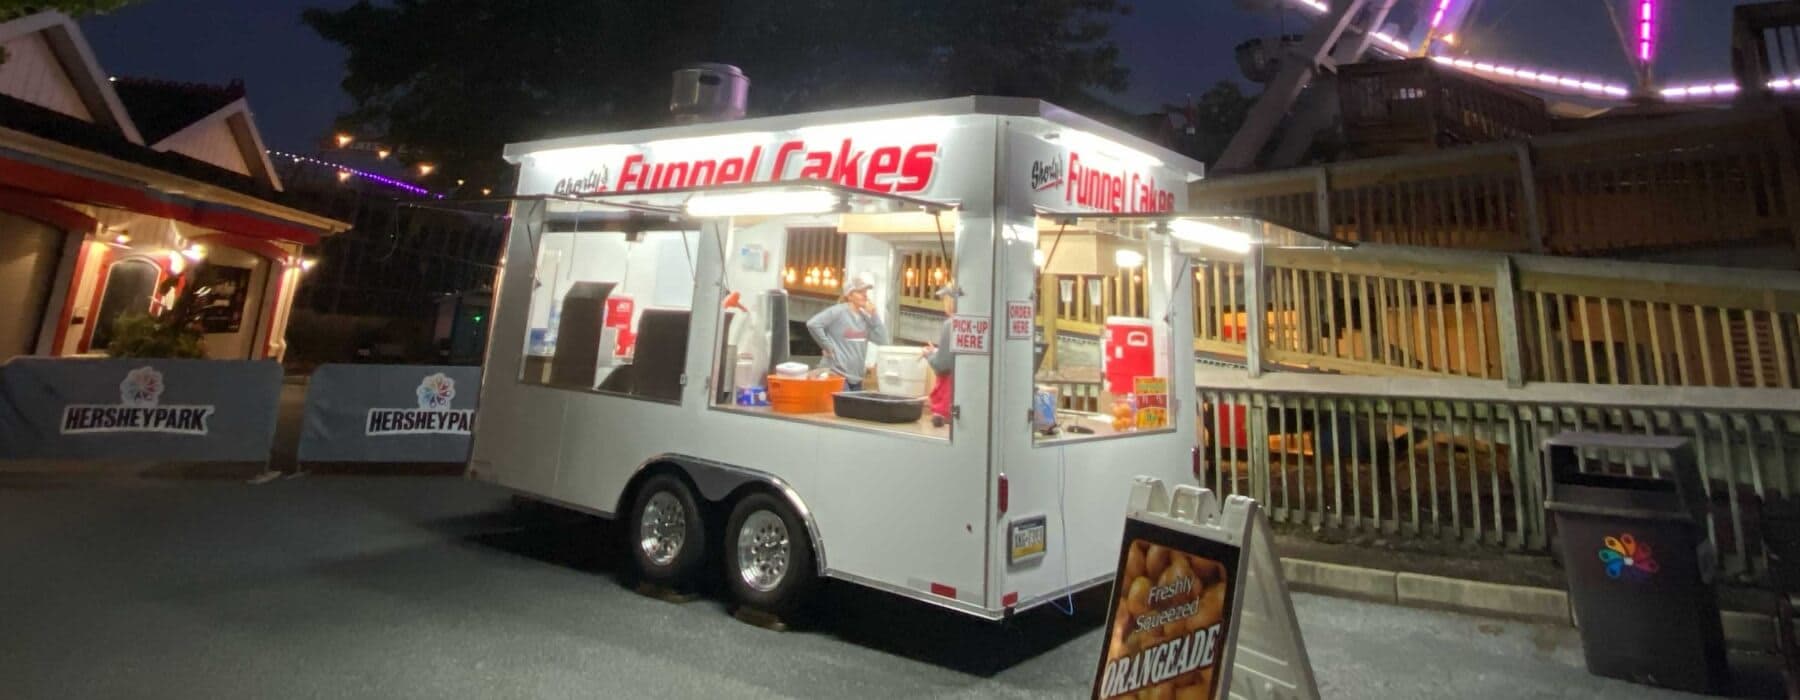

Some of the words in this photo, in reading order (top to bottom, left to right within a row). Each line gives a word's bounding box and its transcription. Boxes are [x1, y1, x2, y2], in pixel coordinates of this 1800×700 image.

[616, 145, 762, 192] Funnel
[770, 138, 938, 193] Cakes
[1066, 152, 1127, 213] Funnel
[1010, 304, 1031, 319] ORDER
[952, 319, 989, 334] PICK-UP
[1013, 320, 1029, 334] HERE
[956, 334, 984, 349] HERE
[65, 407, 206, 430] HERSHEYPARK
[369, 410, 474, 432] HERSHEYPA
[1148, 575, 1195, 604] Freshly
[1135, 597, 1200, 632] Squeezed
[1102, 624, 1221, 698] ORANGEADE
